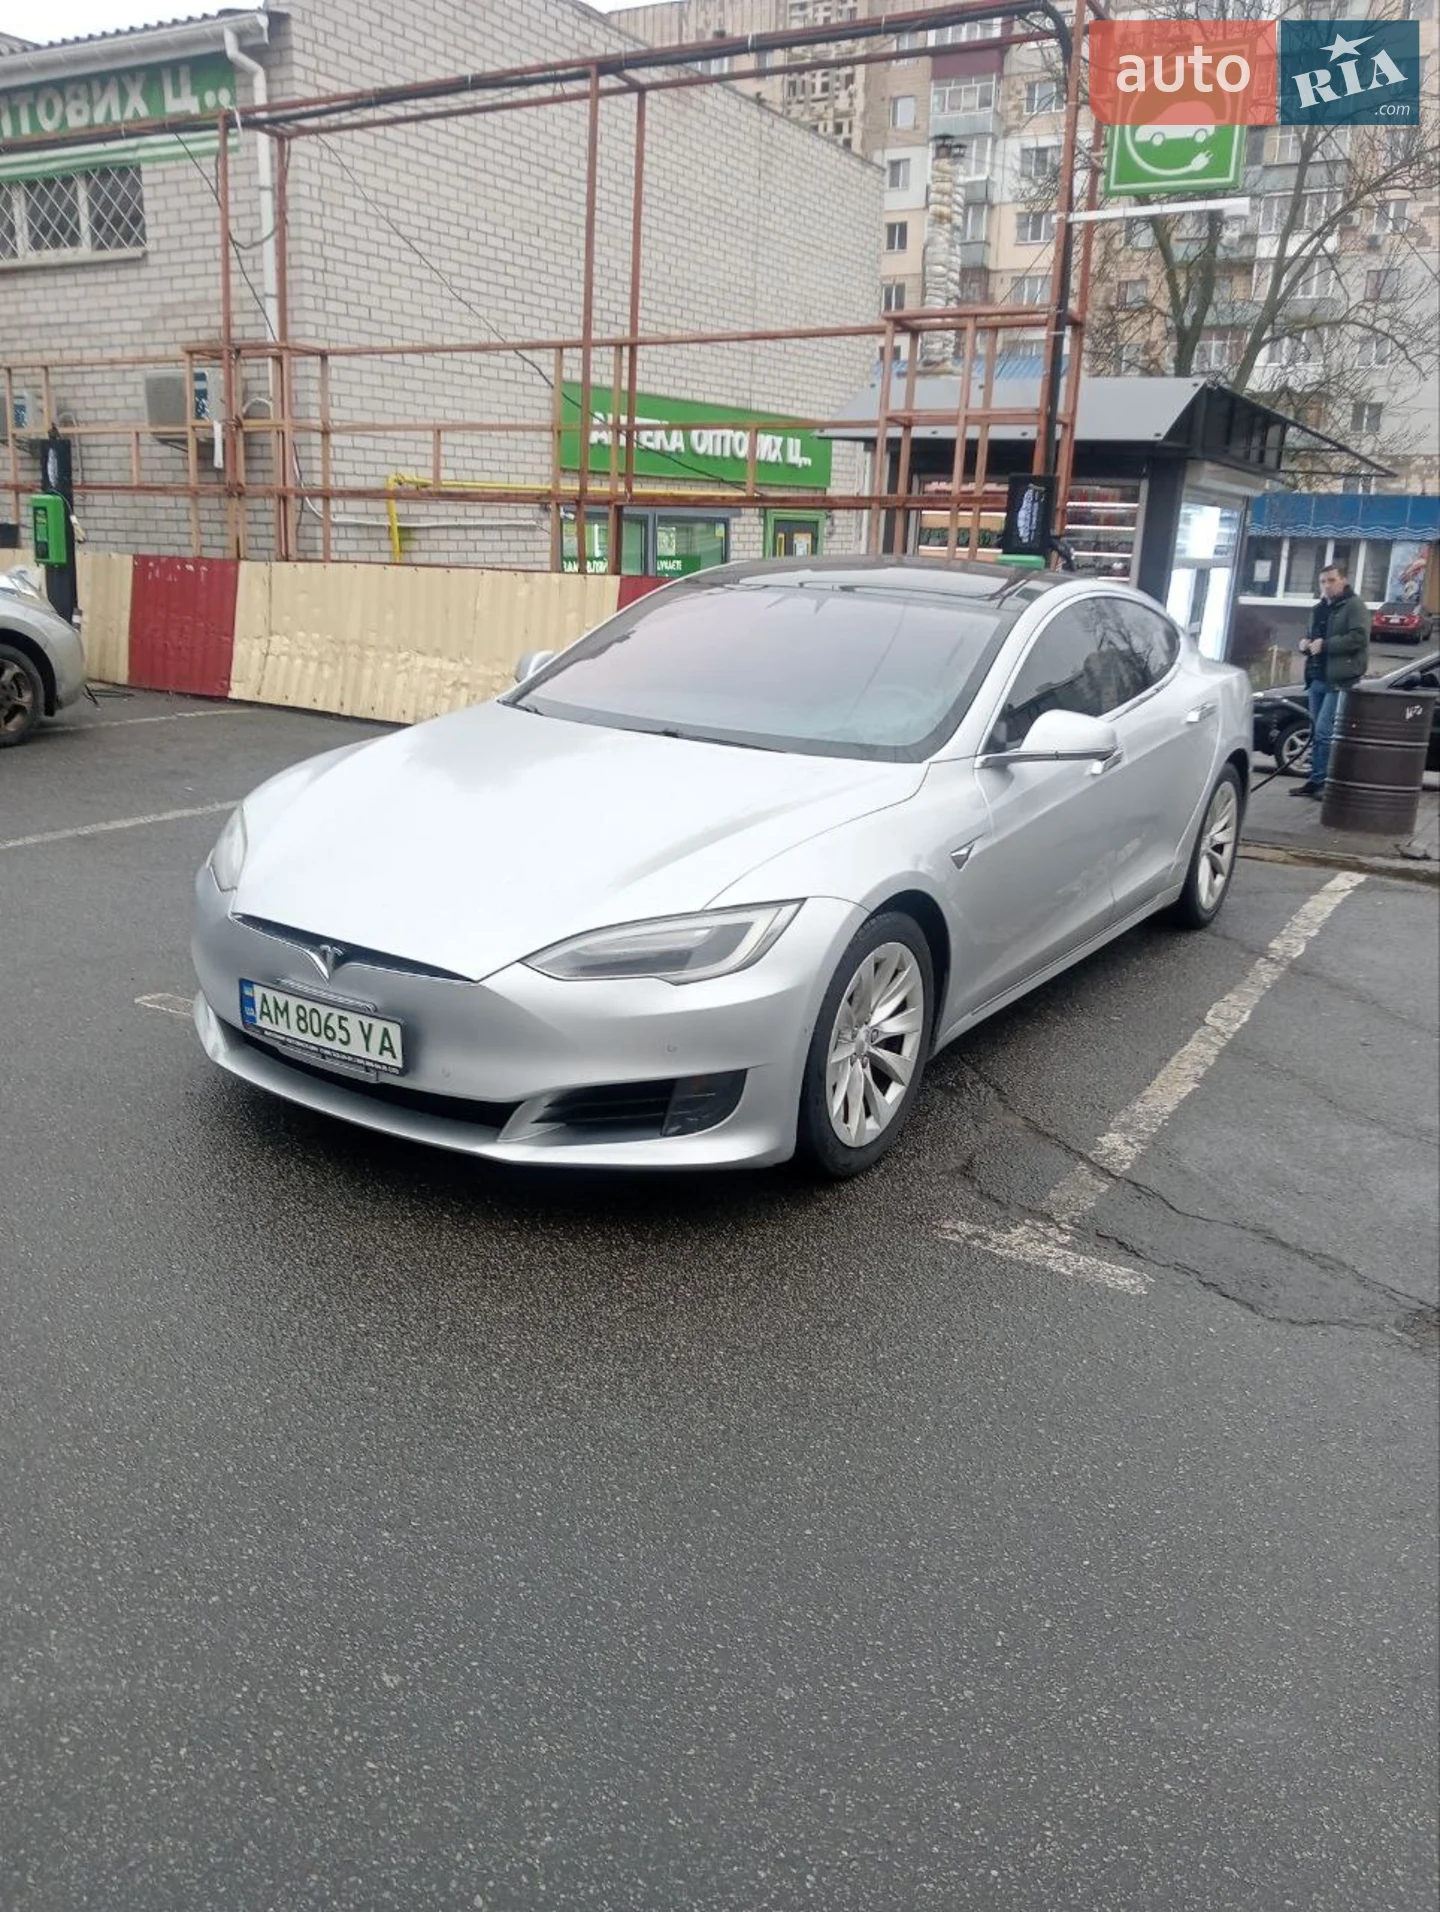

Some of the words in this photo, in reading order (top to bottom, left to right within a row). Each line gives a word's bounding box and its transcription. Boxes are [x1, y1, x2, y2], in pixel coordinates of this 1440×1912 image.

[690, 429, 784, 464] ОПТОИХ
[260, 992, 291, 1030] AM
[296, 1004, 351, 1046] 8065
[359, 1020, 397, 1060] YA
